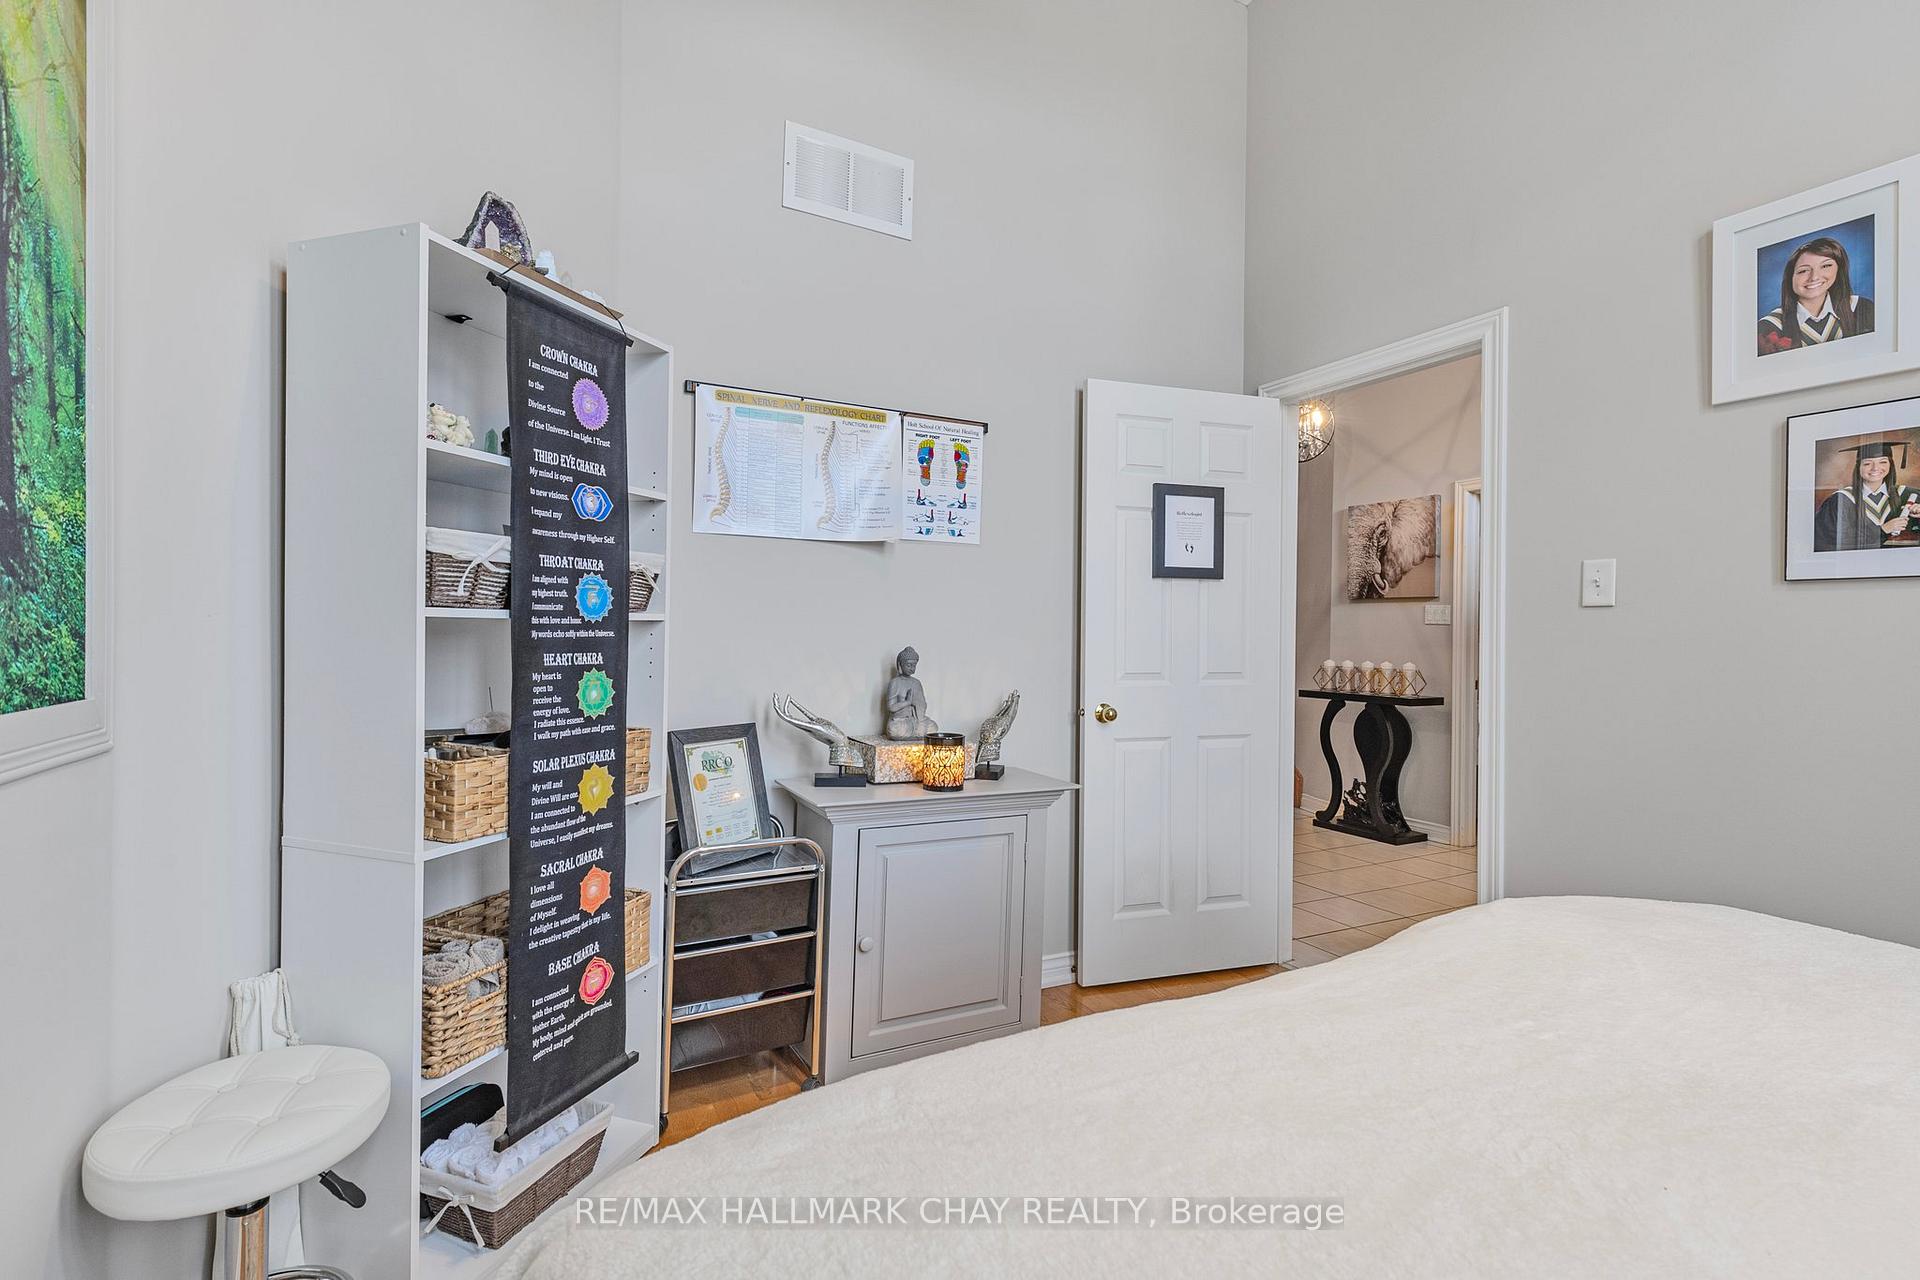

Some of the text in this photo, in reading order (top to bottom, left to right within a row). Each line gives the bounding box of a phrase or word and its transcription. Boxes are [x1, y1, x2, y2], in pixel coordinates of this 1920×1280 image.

[540, 345, 598, 377] CROWN CHAKRA
[541, 365, 568, 379] connected
[535, 381, 544, 390] the
[528, 399, 566, 416] Divine Source
[717, 392, 745, 403] SPINAL
[752, 397, 778, 408] NERVE
[784, 401, 800, 411] AND
[804, 404, 859, 419] REFLEXOLOGY
[860, 412, 886, 422] CHART
[535, 421, 544, 430] the
[596, 437, 610, 447] Trust
[533, 448, 606, 476] THIRD EYE CHAKRA
[530, 467, 538, 477] My
[539, 470, 553, 479] mind
[553, 512, 562, 520] my
[559, 530, 579, 541] through
[580, 534, 586, 542] my
[587, 534, 603, 543] Higher
[539, 554, 604, 571] THROAT CHAKRA
[557, 576, 568, 584] with
[538, 589, 554, 598] highest
[539, 616, 549, 624] with
[550, 616, 560, 624] love
[539, 630, 552, 638] words
[544, 653, 603, 666] HEART CHAKRA
[532, 672, 561, 682] My heart is
[533, 686, 546, 694] open
[533, 695, 561, 705] receive the
[533, 709, 551, 717] energy
[538, 719, 556, 727] radiate
[538, 732, 550, 740] walk
[560, 729, 571, 739] path
[572, 727, 581, 735] with
[533, 749, 615, 773] SOLAR PLEXUS CHAKRA
[532, 780, 563, 793] My will and
[532, 796, 549, 806] Divine
[550, 794, 561, 802] Will
[531, 812, 533, 820] I
[544, 805, 570, 817] connected
[530, 825, 539, 834] the
[541, 821, 566, 832] abundant
[560, 832, 574, 841] easily
[589, 825, 595, 833] my
[540, 847, 604, 877] SACRAL CHAKRA
[530, 887, 533, 895] I
[534, 884, 546, 893] love
[530, 893, 563, 908] dimensions
[530, 913, 537, 922] of
[533, 923, 553, 935] delight
[560, 913, 580, 925] weaving
[529, 941, 538, 950] the
[539, 933, 561, 945] creative
[593, 916, 601, 924] my
[548, 941, 600, 976] BASE CHAKRA
[535, 998, 543, 1006] am
[544, 985, 569, 1002] connected
[532, 1009, 543, 1020] with
[544, 1006, 552, 1015] the
[532, 1021, 550, 1034] Mother
[554, 1024, 567, 1037] mind
[553, 1039, 563, 1050] and
